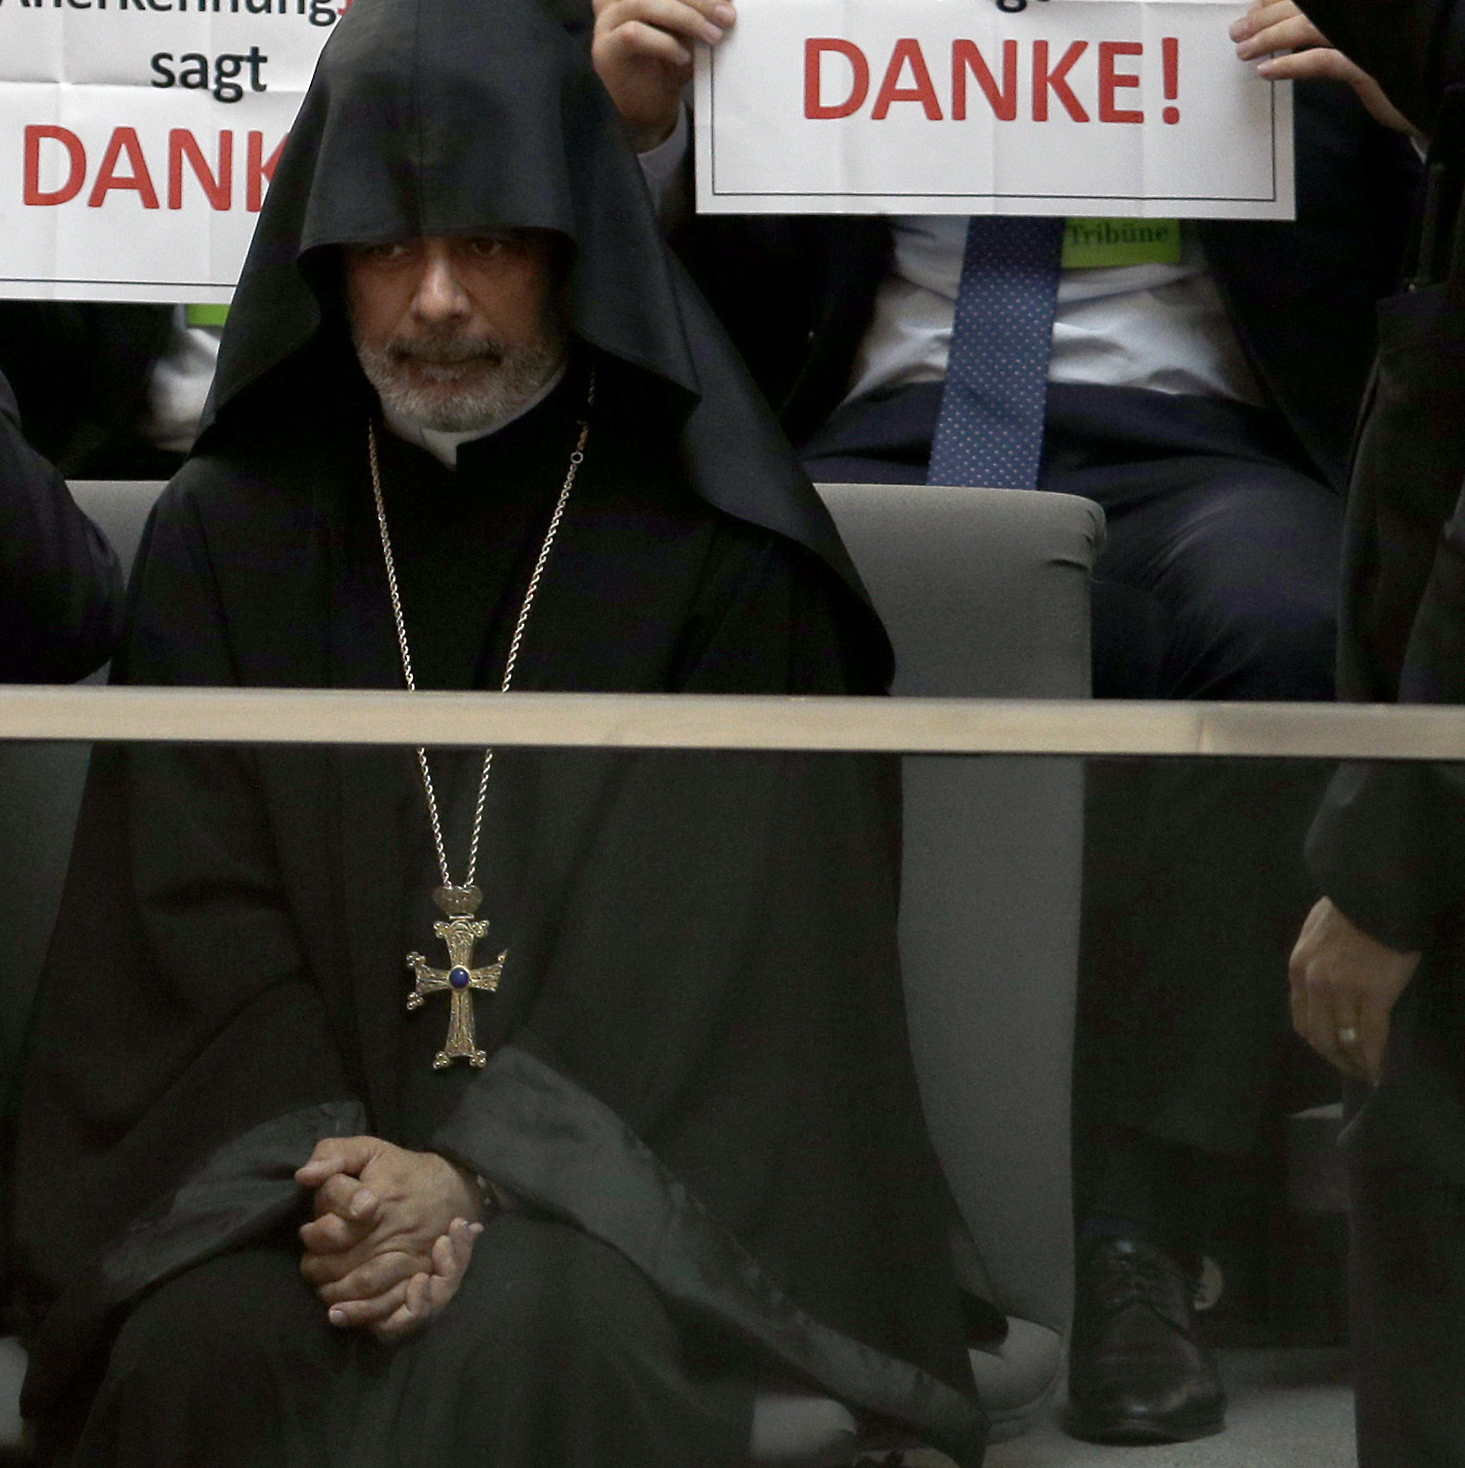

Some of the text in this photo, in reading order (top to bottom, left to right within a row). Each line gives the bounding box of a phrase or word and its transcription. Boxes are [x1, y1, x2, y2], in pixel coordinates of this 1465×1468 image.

[150, 46, 268, 104] sagt
[803, 37, 1181, 125] DANKE!
[23, 124, 291, 212] DANK
